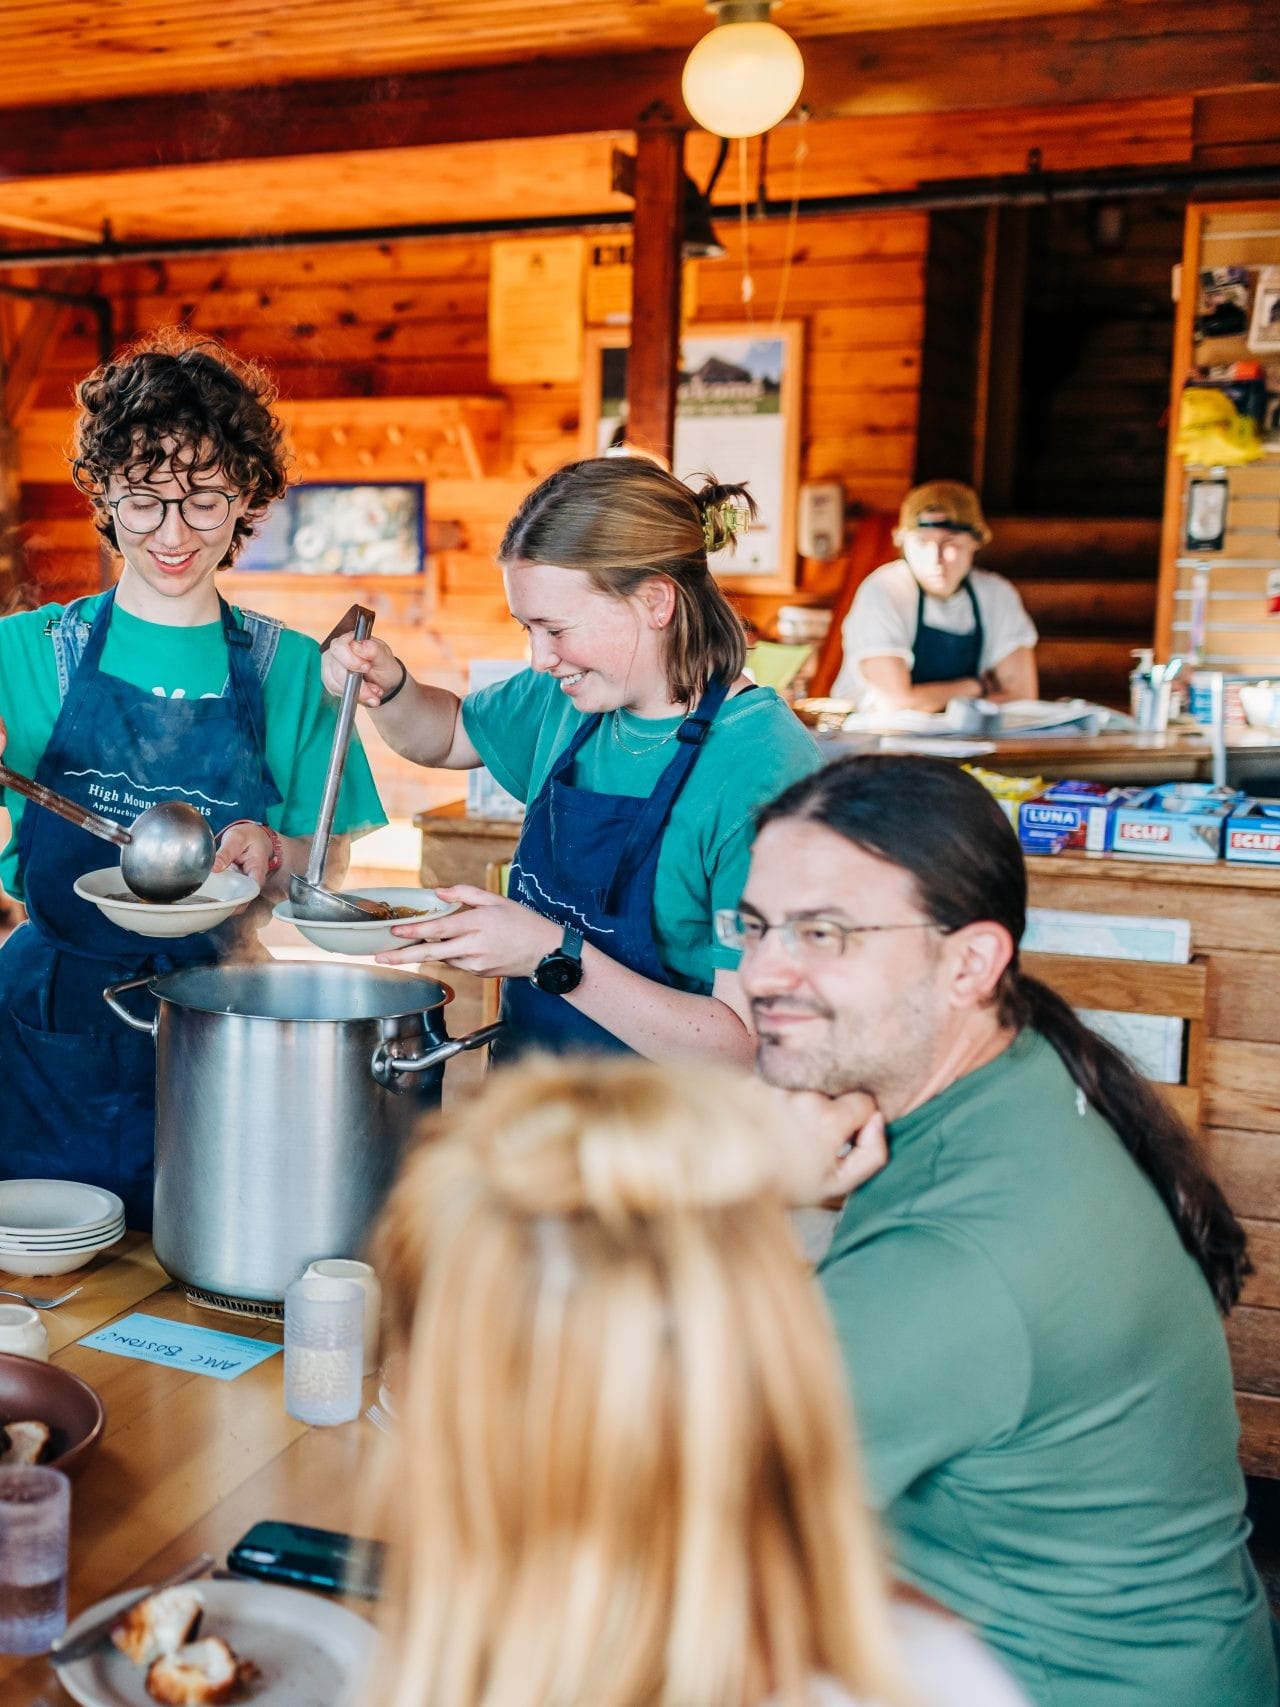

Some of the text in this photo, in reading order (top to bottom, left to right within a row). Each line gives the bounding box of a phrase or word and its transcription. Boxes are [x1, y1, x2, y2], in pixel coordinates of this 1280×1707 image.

[88, 783, 119, 802] High
[1028, 808, 1076, 825] LUNA
[115, 1335, 242, 1371] AMC BOSTON
